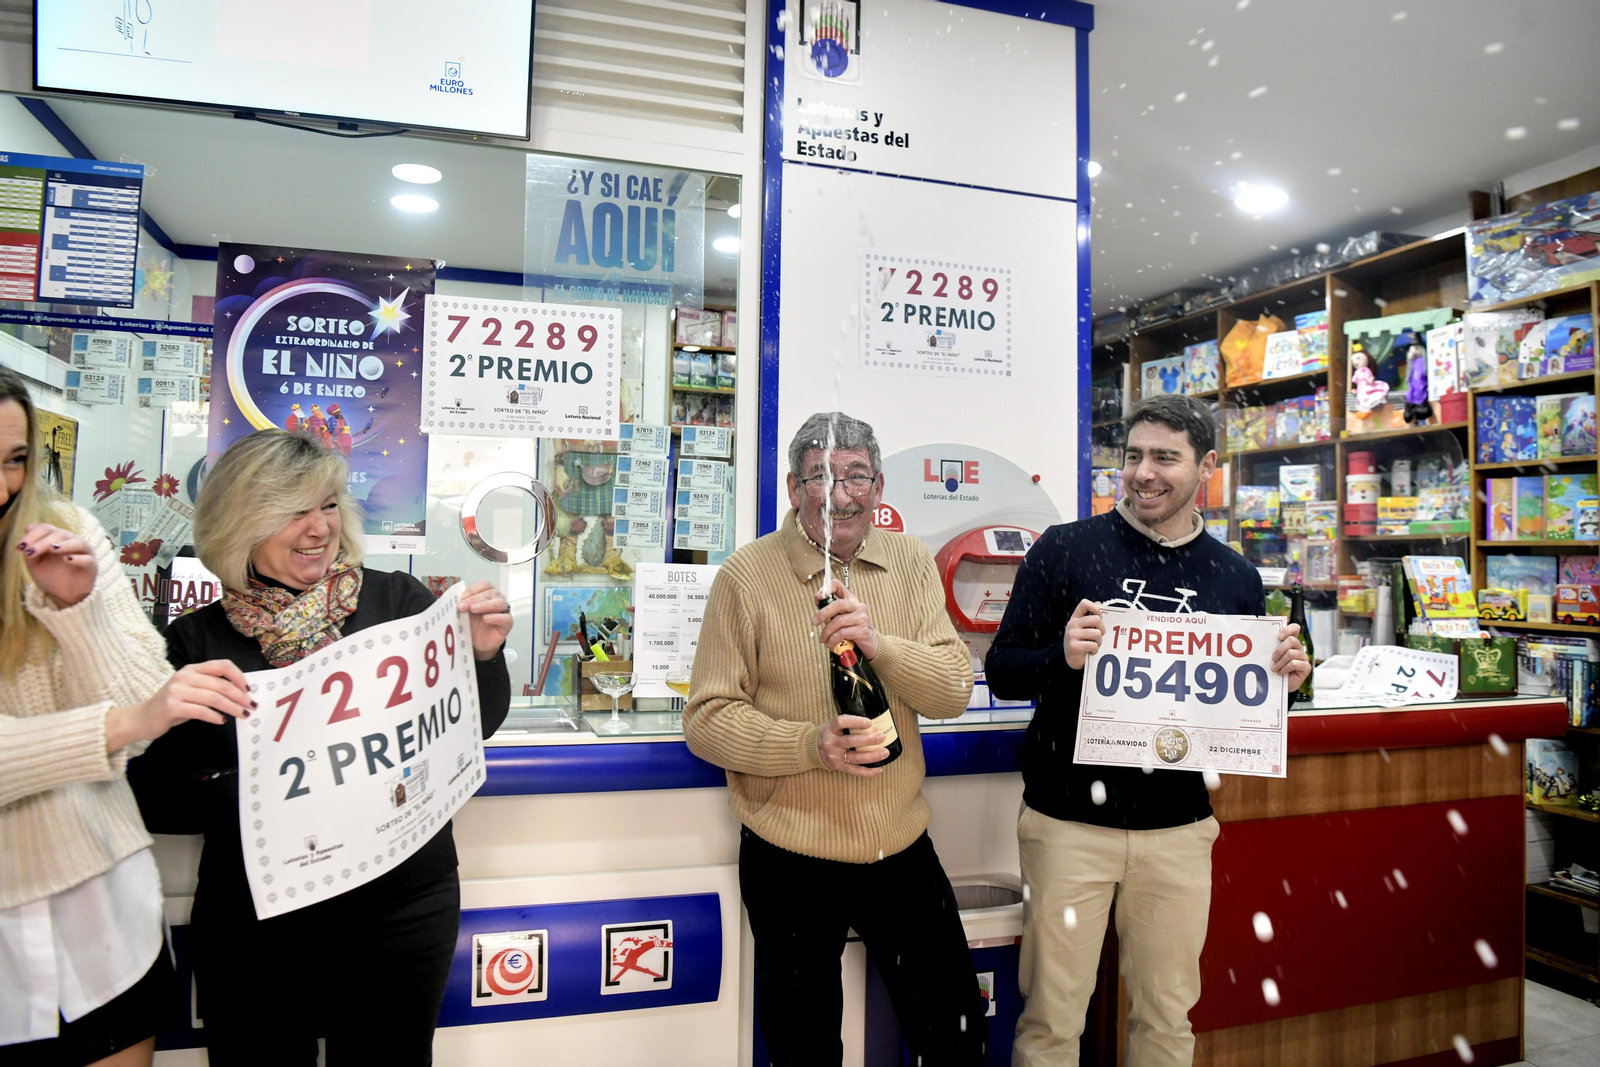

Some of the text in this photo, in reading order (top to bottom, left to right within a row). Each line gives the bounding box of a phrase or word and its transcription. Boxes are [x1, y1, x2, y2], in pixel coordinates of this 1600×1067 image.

[429, 84, 474, 96] MILLONES
[440, 78, 465, 88] EURO
[874, 112, 883, 127] y
[797, 123, 909, 148] Apuestas del
[797, 140, 857, 162] Estado
[567, 169, 663, 203] ¿Y SI CAE
[554, 196, 679, 273] AQUÍ
[607, 288, 620, 302] DE
[286, 315, 365, 336] SORTEO
[904, 303, 995, 331] PREMIO
[275, 335, 374, 350] EXTRAORDINARIO DE
[446, 314, 599, 353] 72289
[262, 348, 296, 376] EL
[478, 355, 593, 385] PREMIO
[279, 381, 366, 398] 6 DE ENERO
[58, 431, 72, 447] FREE
[960, 494, 980, 502] Estado
[872, 507, 893, 526] 18
[667, 570, 697, 583] BOTES
[1146, 614, 1207, 625] VENDIDO AQUÍ
[1127, 627, 1253, 658] PREMIO
[272, 624, 456, 743] 72289
[1095, 653, 1269, 707] 05490
[326, 686, 462, 786] PREMIO
[1116, 740, 1147, 748] NAVIDAD
[1220, 746, 1262, 756] DICIEMBRE
[375, 815, 403, 835] SORTEO
